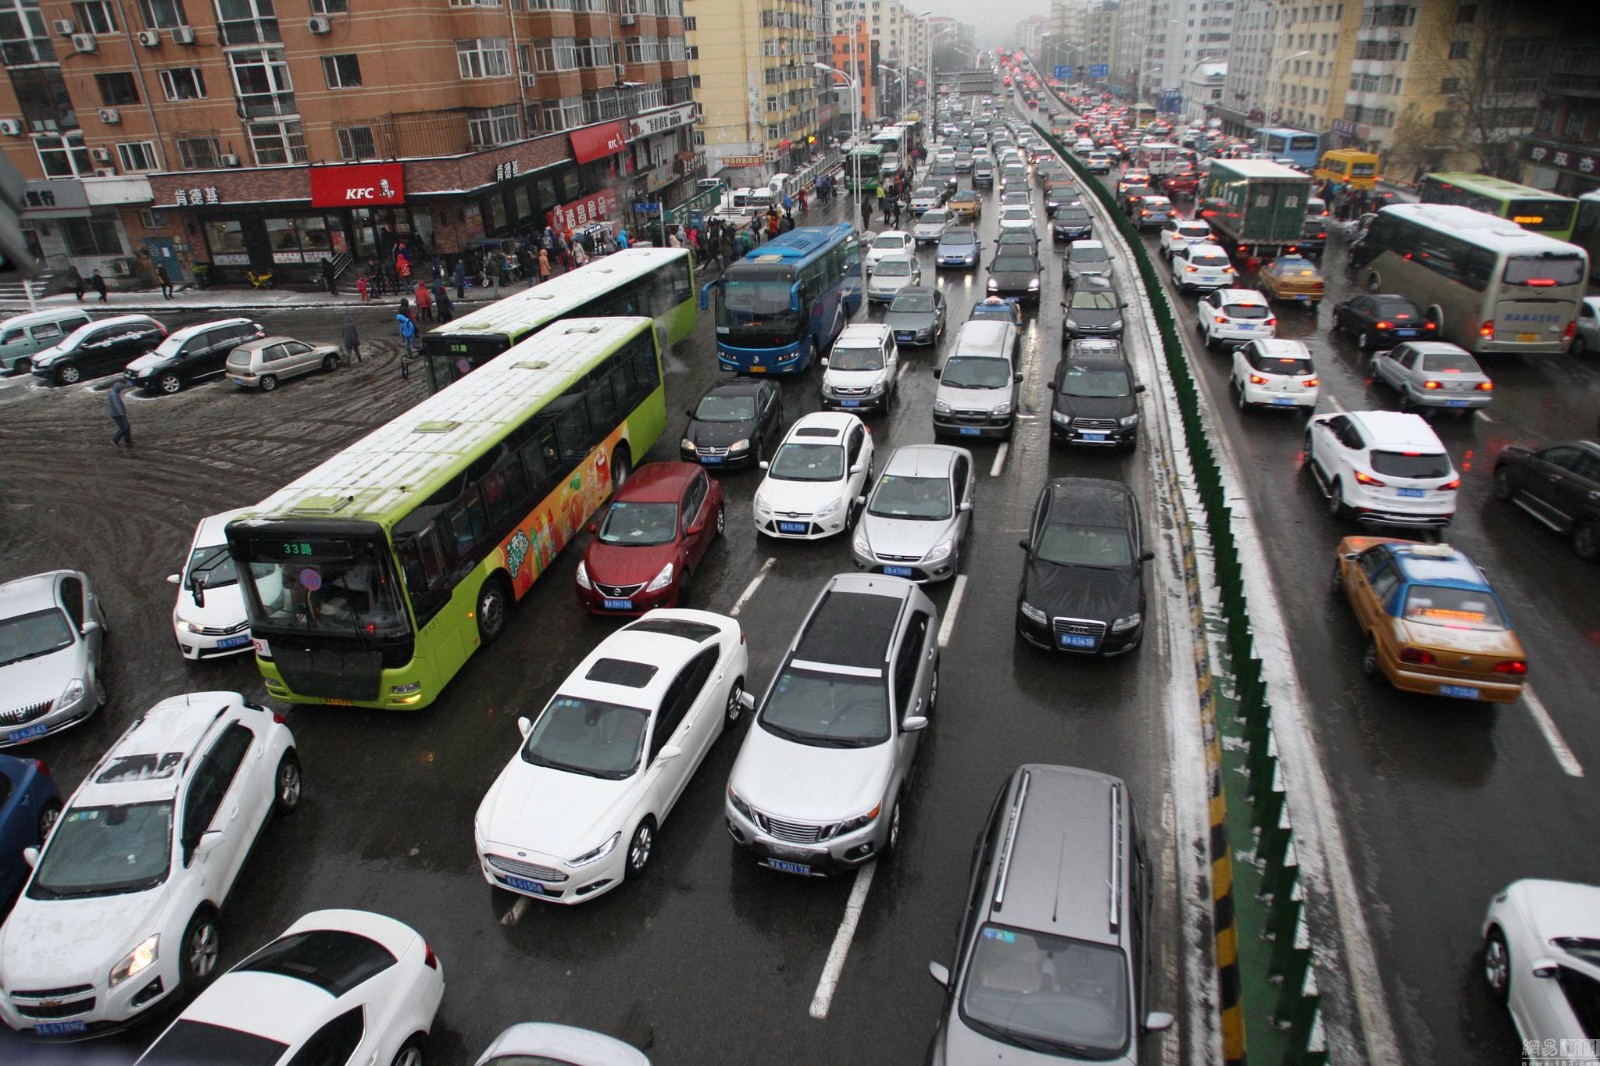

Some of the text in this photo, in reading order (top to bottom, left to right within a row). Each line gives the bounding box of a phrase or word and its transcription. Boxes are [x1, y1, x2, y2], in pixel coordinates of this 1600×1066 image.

[607, 138, 618, 149] KFC
[175, 187, 219, 206] 肯德基
[346, 187, 374, 200] KFC
[284, 544, 312, 556] 33路
